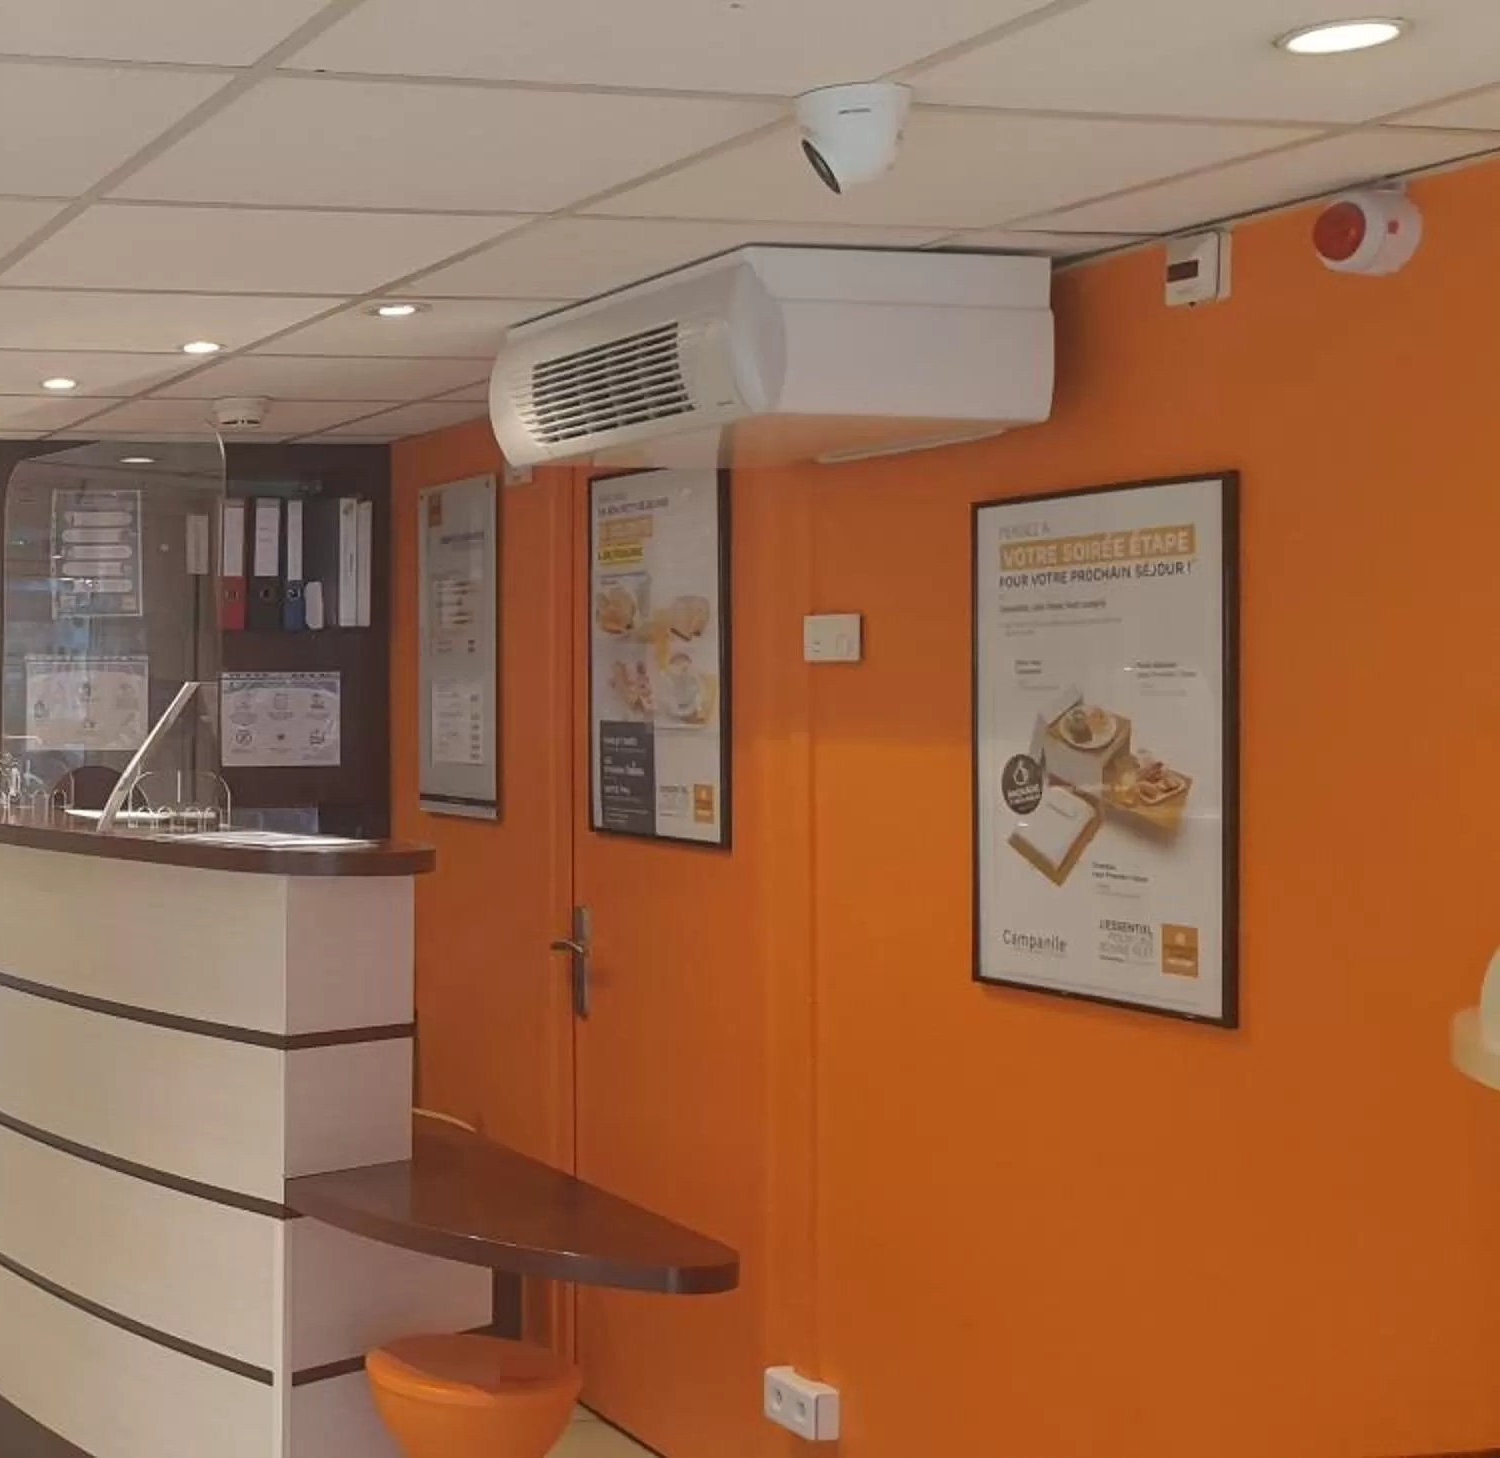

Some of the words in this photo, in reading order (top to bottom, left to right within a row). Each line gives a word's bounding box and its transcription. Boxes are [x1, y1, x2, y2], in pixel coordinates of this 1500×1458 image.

[1003, 544, 1057, 567] VOTRE
[1063, 532, 1125, 562] SOIRÉE
[1129, 529, 1189, 557] ÉTAPE
[1031, 570, 1068, 586] VOTRE
[1070, 563, 1131, 584] PROCHAIN
[1003, 929, 1068, 953] Campanile
